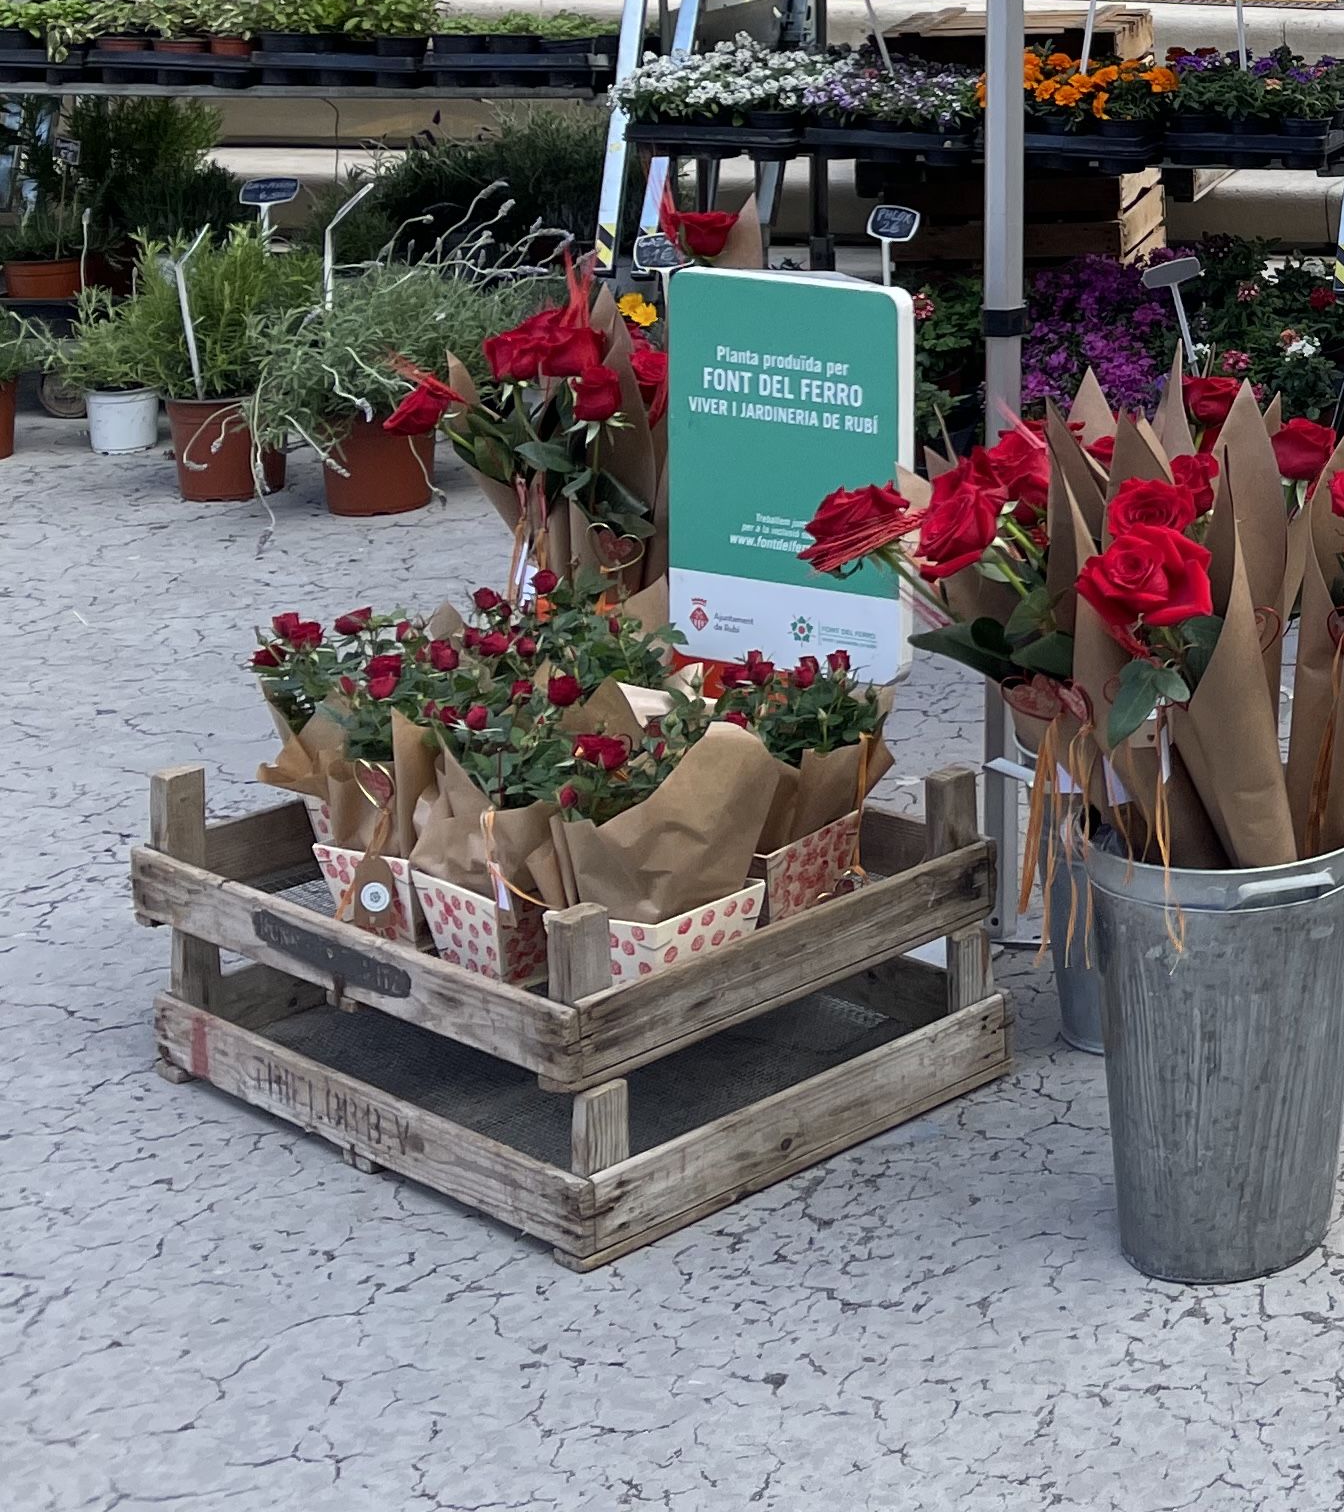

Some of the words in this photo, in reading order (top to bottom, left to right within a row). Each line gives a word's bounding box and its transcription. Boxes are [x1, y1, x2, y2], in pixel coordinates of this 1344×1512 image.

[716, 345, 759, 365] Planta
[763, 353, 822, 373] produïda
[826, 360, 850, 377] per
[703, 366, 751, 395] FONT
[759, 373, 793, 400] DEL
[800, 378, 863, 408] FERRO
[688, 396, 728, 416] VIVER
[732, 401, 737, 417] I
[740, 402, 818, 429] JARDINERIA
[823, 412, 840, 431] DE
[844, 413, 879, 435] RUBÍ
